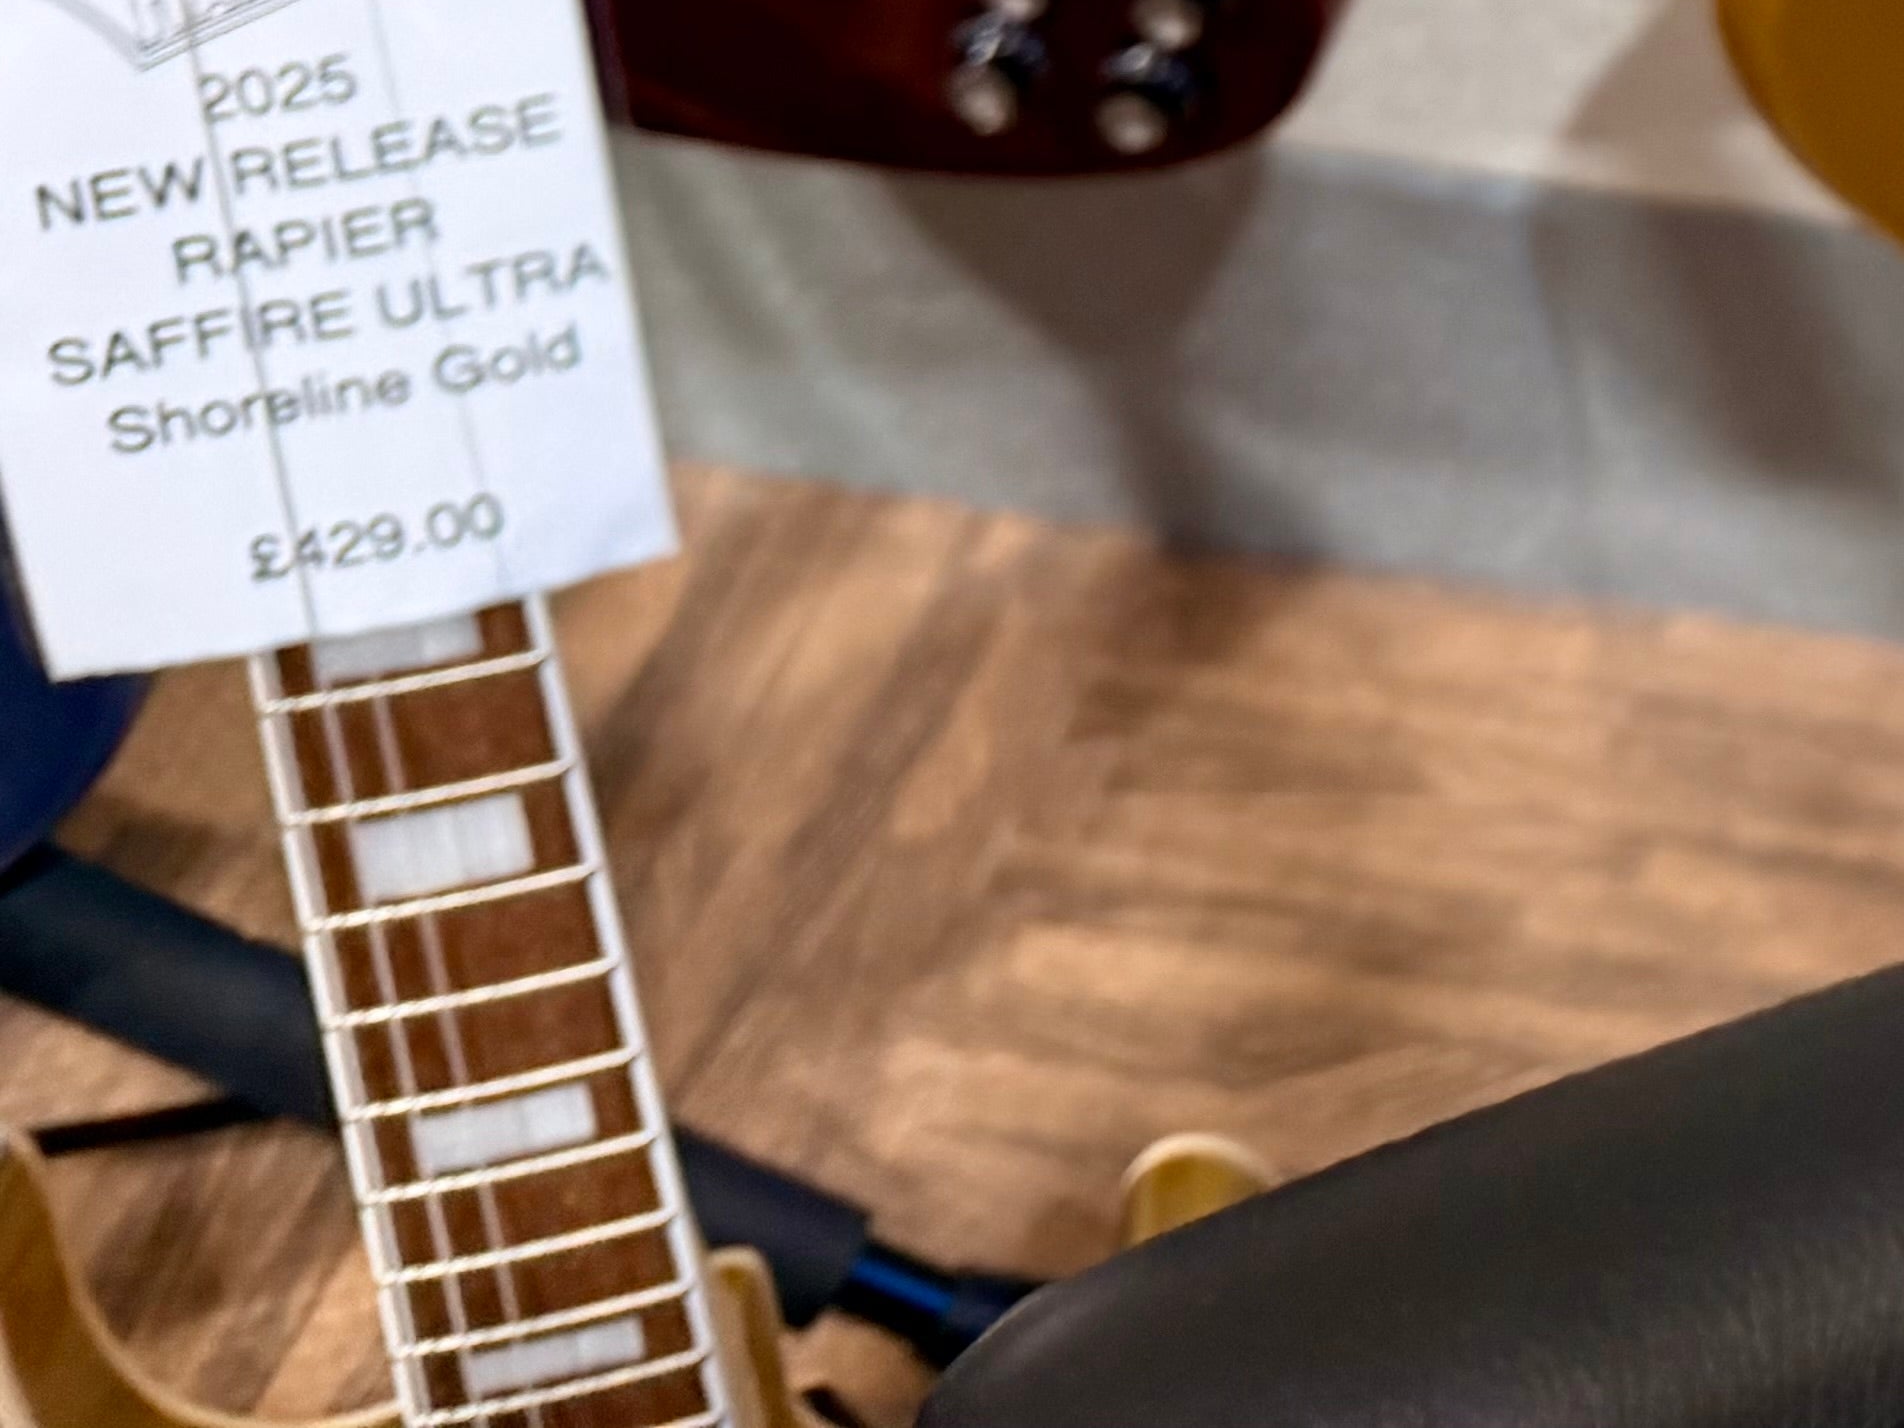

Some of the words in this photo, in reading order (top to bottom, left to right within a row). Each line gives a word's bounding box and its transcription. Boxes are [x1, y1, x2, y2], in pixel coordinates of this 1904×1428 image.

[202, 54, 358, 124] 2025
[36, 156, 204, 231] NEW
[232, 93, 565, 197] RELEASE
[172, 198, 439, 286] RAPIER
[47, 290, 355, 388] SAFFIRE
[375, 243, 612, 331] ULTRA
[107, 362, 412, 454] Shoreline
[433, 322, 582, 398] Gold
[249, 492, 506, 584] £429.00
